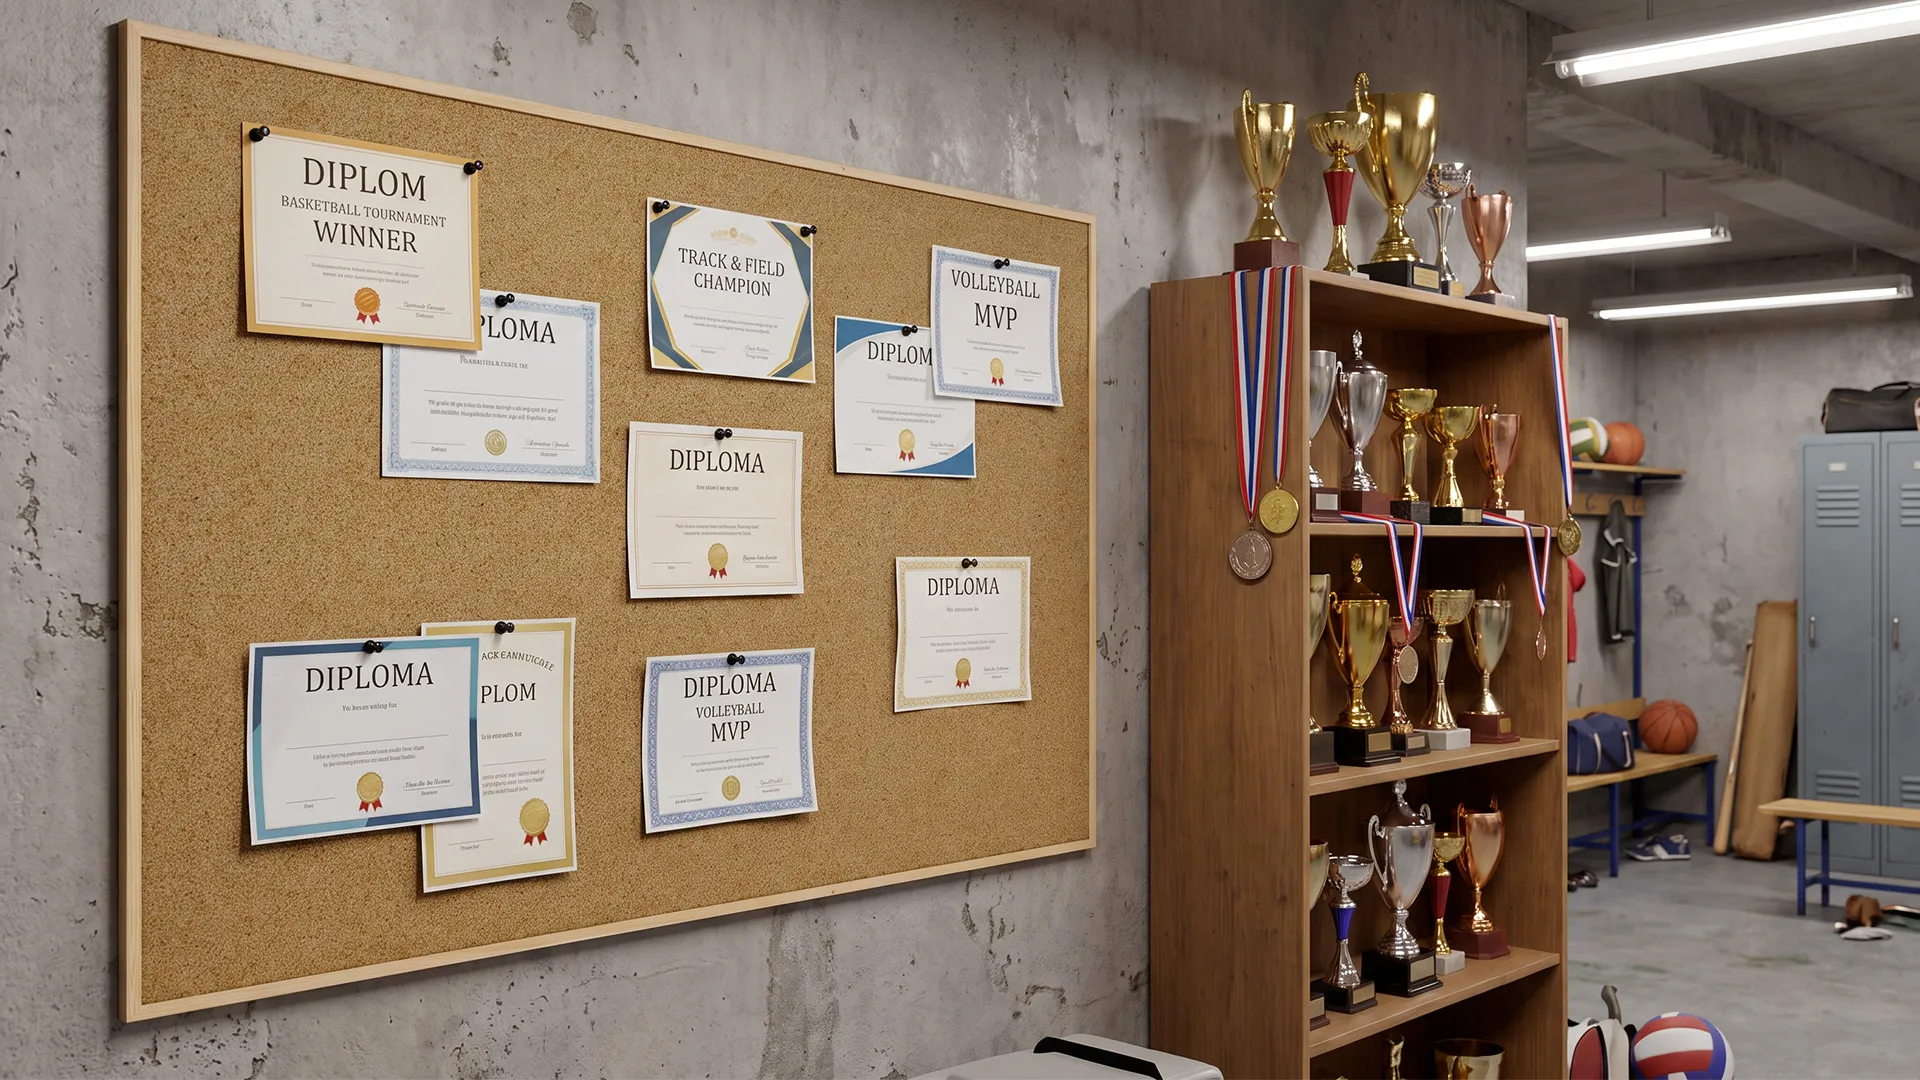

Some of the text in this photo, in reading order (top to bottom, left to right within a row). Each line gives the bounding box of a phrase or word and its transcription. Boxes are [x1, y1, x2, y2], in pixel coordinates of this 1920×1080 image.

[303, 156, 426, 202] DIPLOM
[281, 195, 447, 228] BASKETBALL TOURNAMENT
[313, 220, 418, 254] WINNER
[678, 247, 785, 277] TRACK & FIELD
[694, 272, 772, 297] CHAMPION
[951, 269, 1040, 299] VOLLEYBALL
[974, 302, 1018, 330] MVP
[670, 449, 765, 474] DIPLOMA
[928, 577, 1000, 596] DIPLOMA
[305, 662, 434, 693] DIPLOMA
[684, 672, 777, 698] DIPLOMA
[696, 702, 765, 719] VOLLEYBALL
[711, 720, 751, 743] MVP
